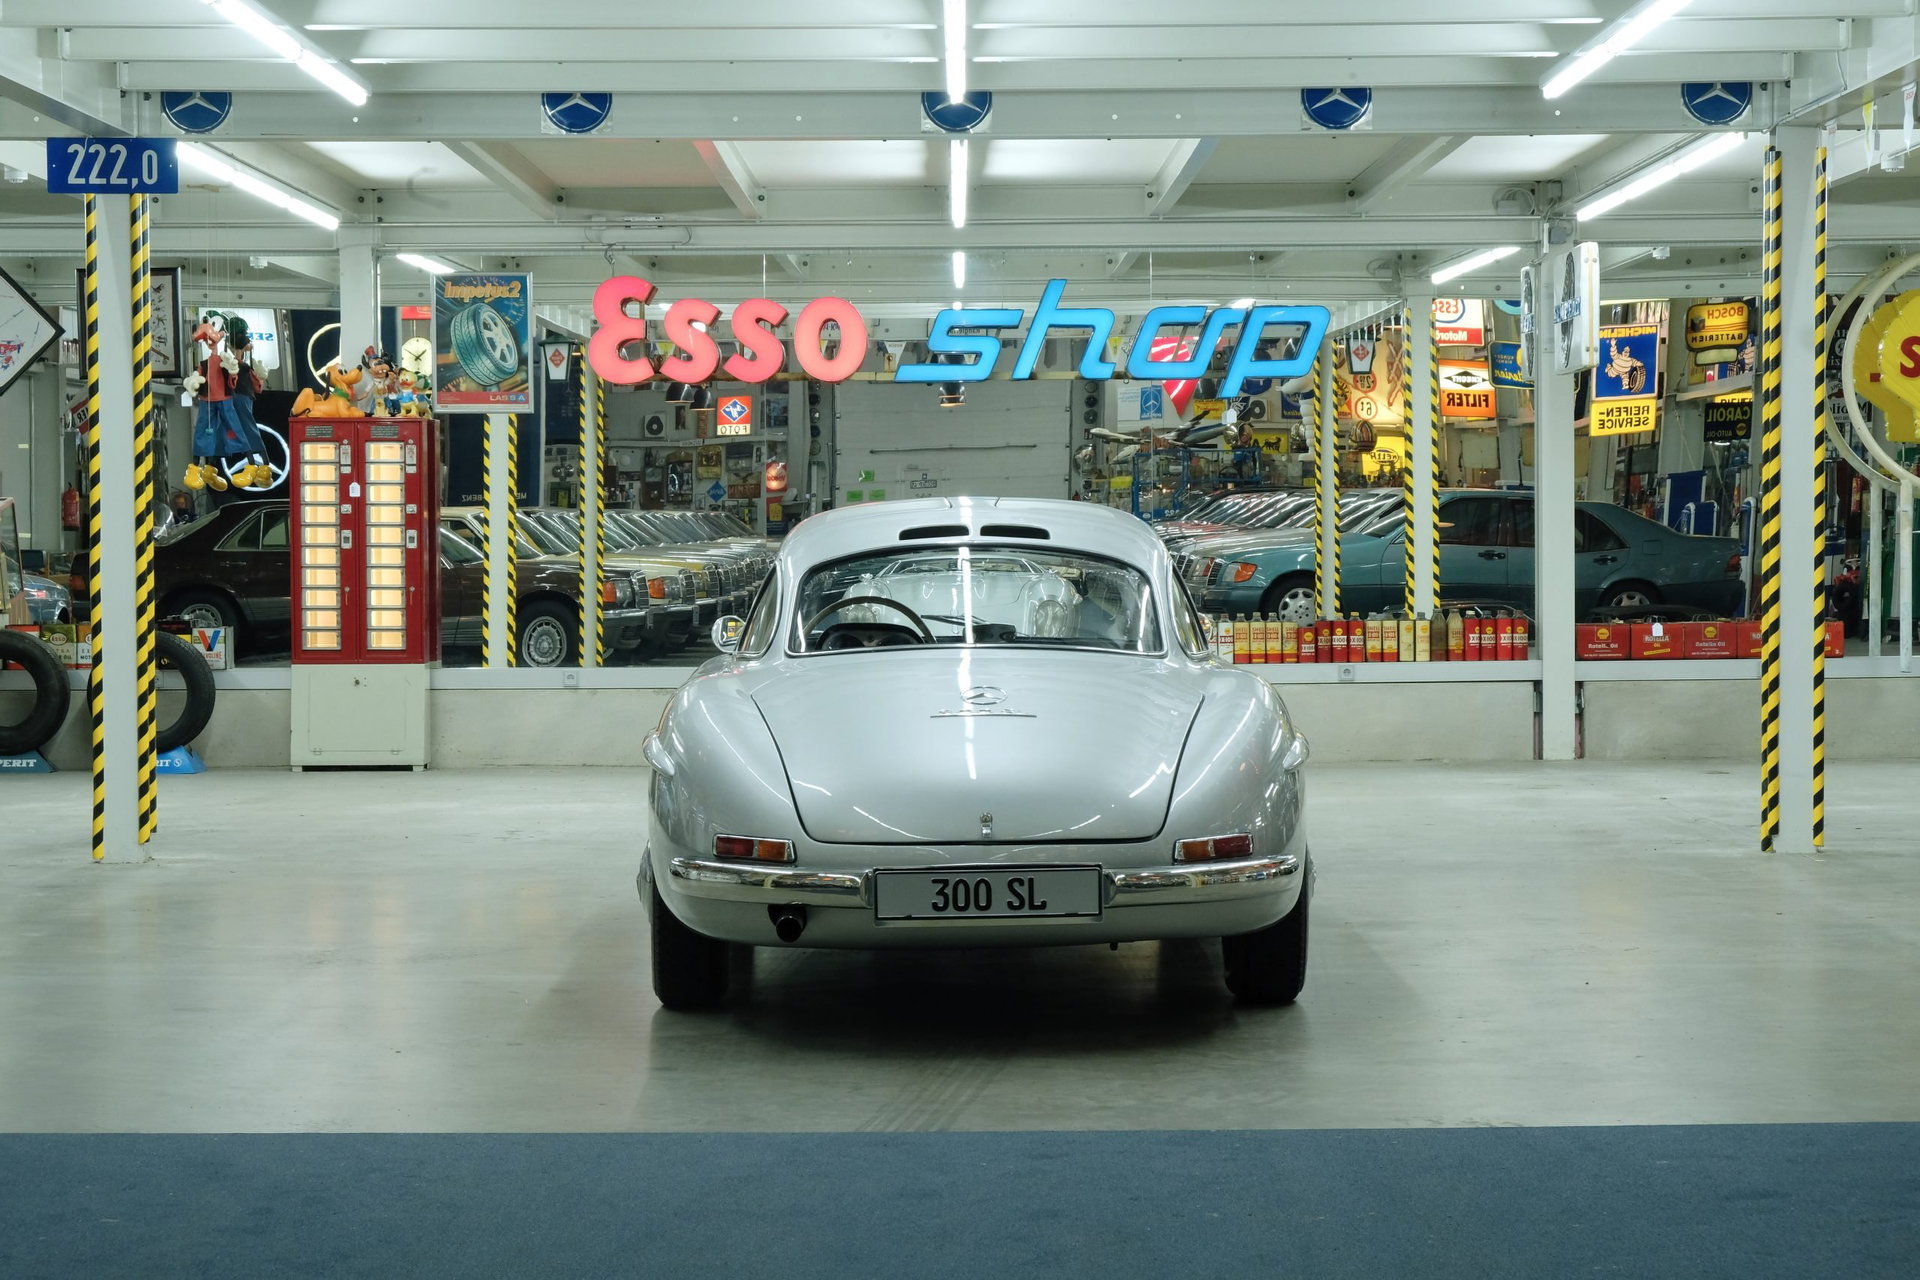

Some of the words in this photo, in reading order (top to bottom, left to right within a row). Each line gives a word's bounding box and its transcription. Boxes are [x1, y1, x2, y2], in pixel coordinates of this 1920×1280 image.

[67, 143, 158, 189] 222,0
[894, 278, 1331, 398] shop
[931, 878, 992, 912] 300
[1007, 877, 1047, 911] SL
